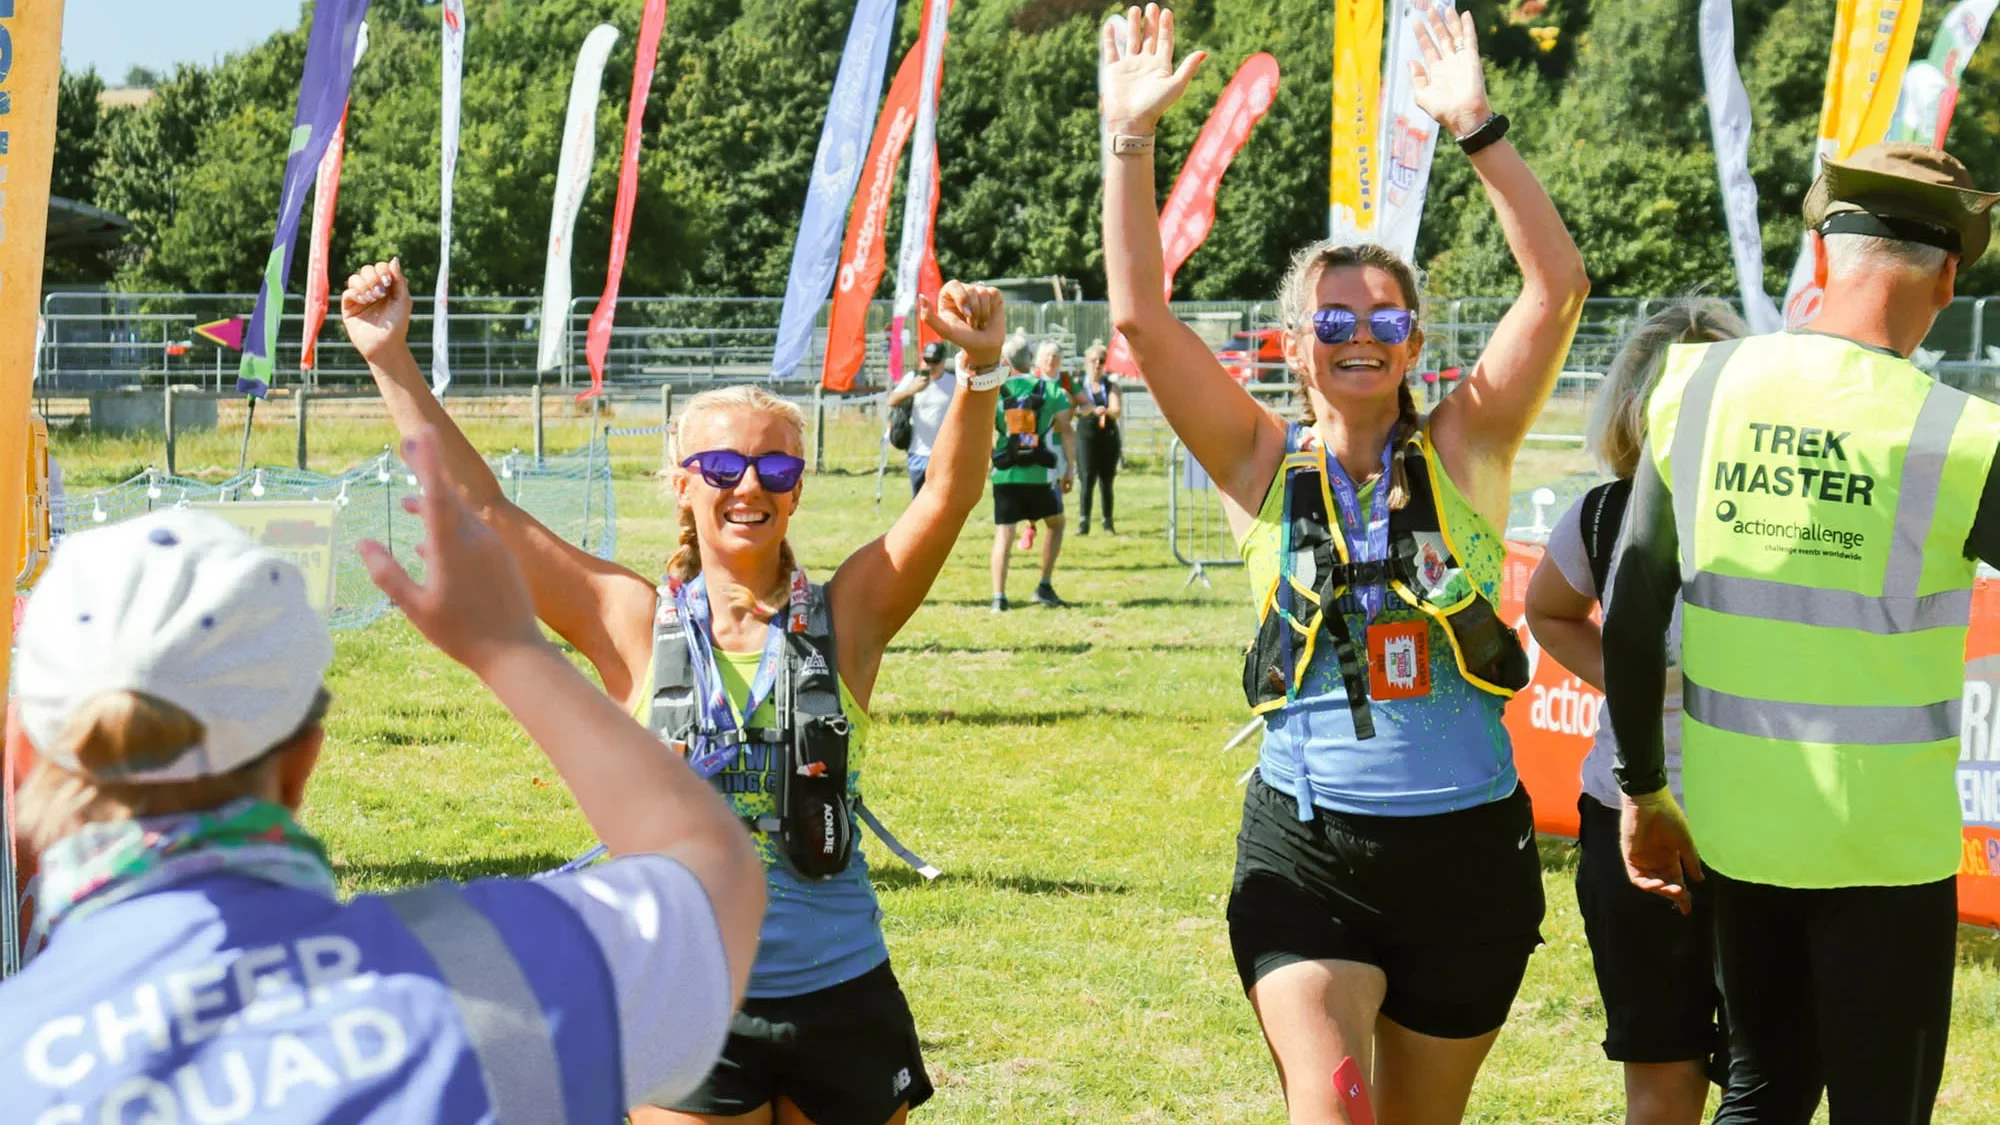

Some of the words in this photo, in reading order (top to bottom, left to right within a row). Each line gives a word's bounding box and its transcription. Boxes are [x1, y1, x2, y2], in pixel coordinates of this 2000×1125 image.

[1749, 422, 1851, 461] TREK
[1714, 461, 1875, 506] MASTER
[1733, 518, 1865, 550] actionchallenge
[1764, 544, 1797, 555] challenge
[1822, 550, 1862, 561] worldwide
[23, 934, 380, 1088] CHEER
